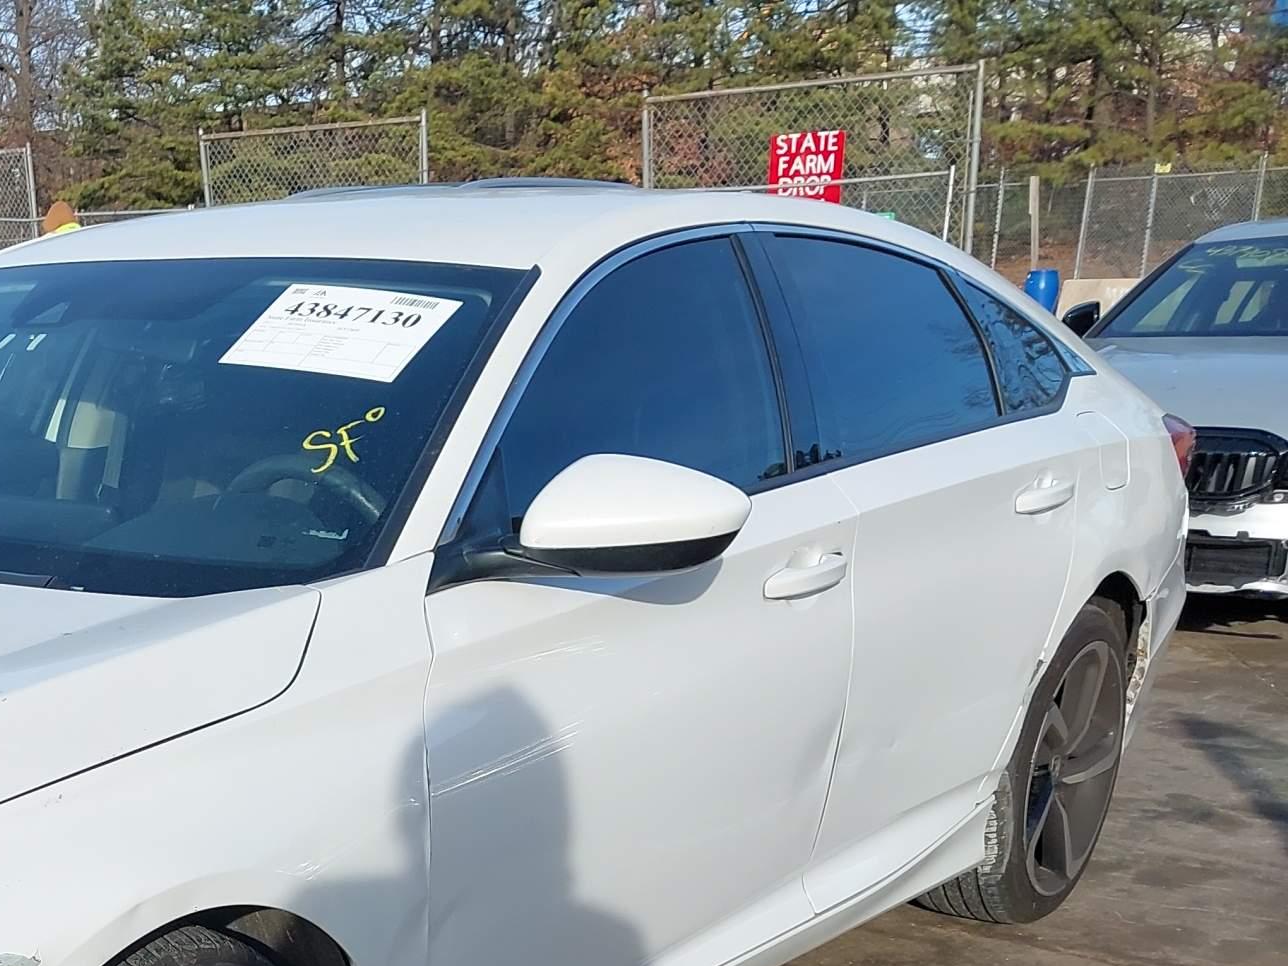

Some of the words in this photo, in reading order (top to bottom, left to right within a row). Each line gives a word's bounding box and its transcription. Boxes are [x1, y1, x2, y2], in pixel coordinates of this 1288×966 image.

[776, 130, 840, 154] STATE
[777, 153, 836, 177] FARM
[777, 175, 833, 197] DROP
[284, 300, 423, 329] 43847130
